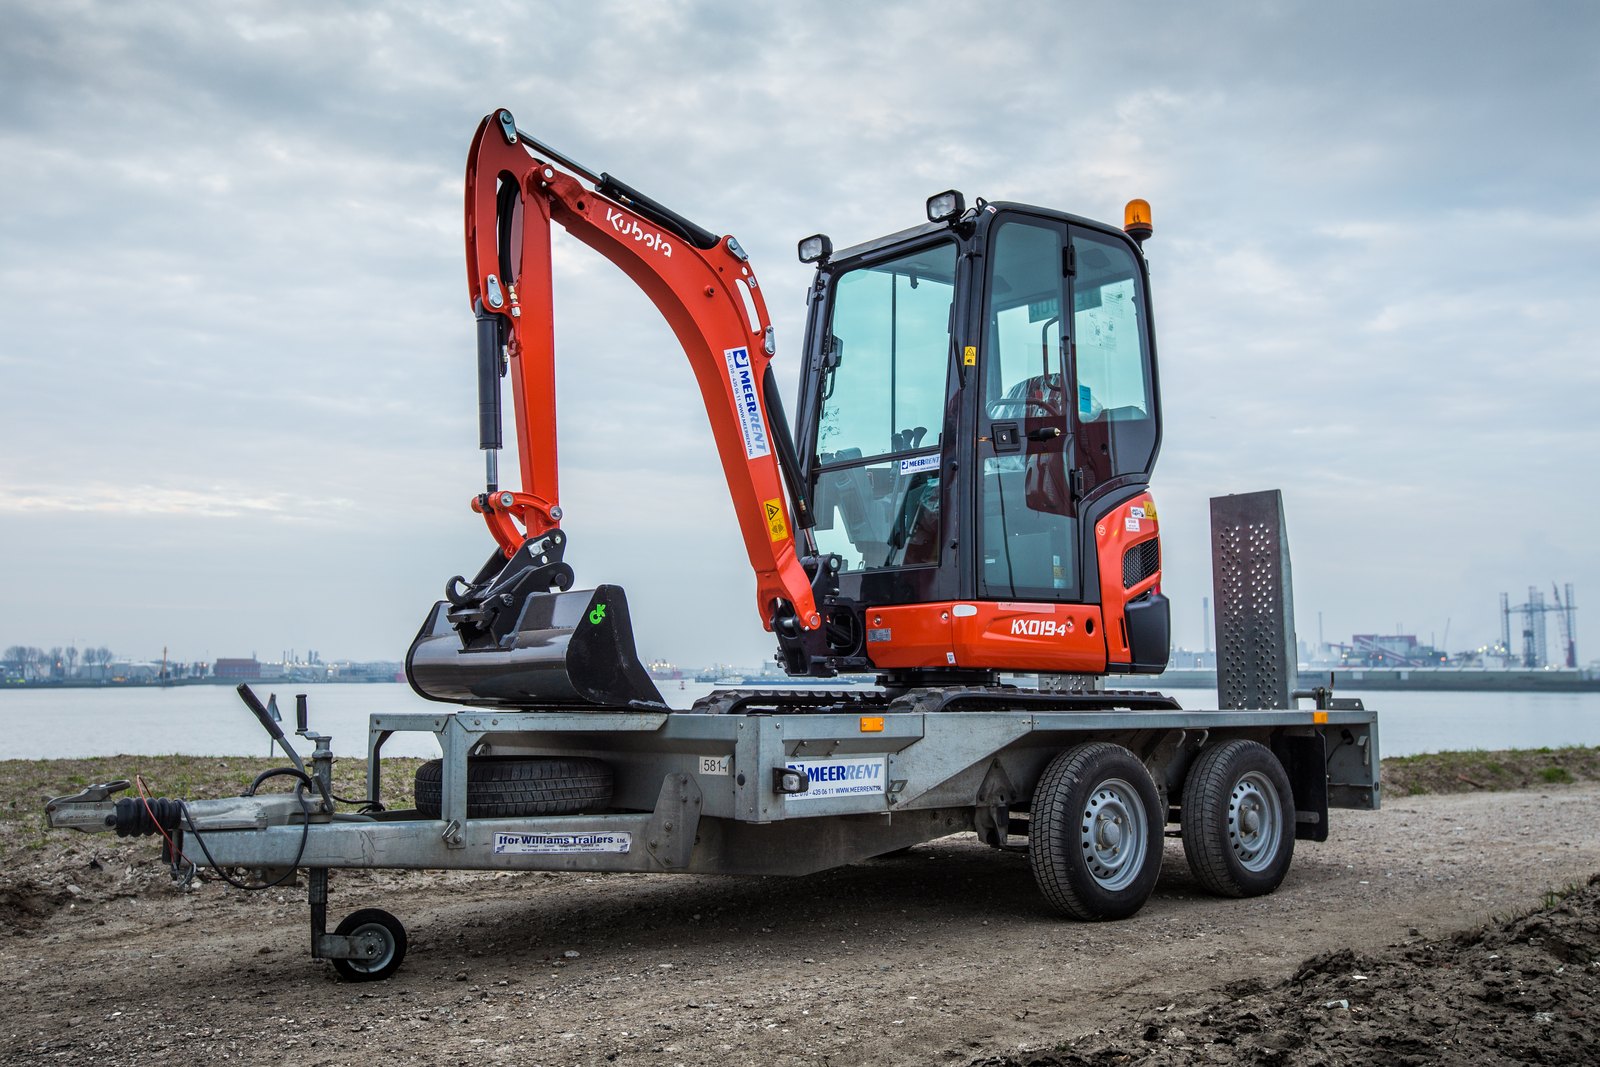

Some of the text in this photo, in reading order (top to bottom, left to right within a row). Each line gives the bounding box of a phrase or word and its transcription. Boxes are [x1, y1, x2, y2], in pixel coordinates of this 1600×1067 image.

[606, 207, 672, 258] Kubota
[739, 370, 767, 453] MEERRENT
[807, 764, 882, 783] MEERRENT
[499, 836, 520, 845] Ifor
[521, 836, 570, 845] Williams
[572, 836, 614, 845] Trailers
